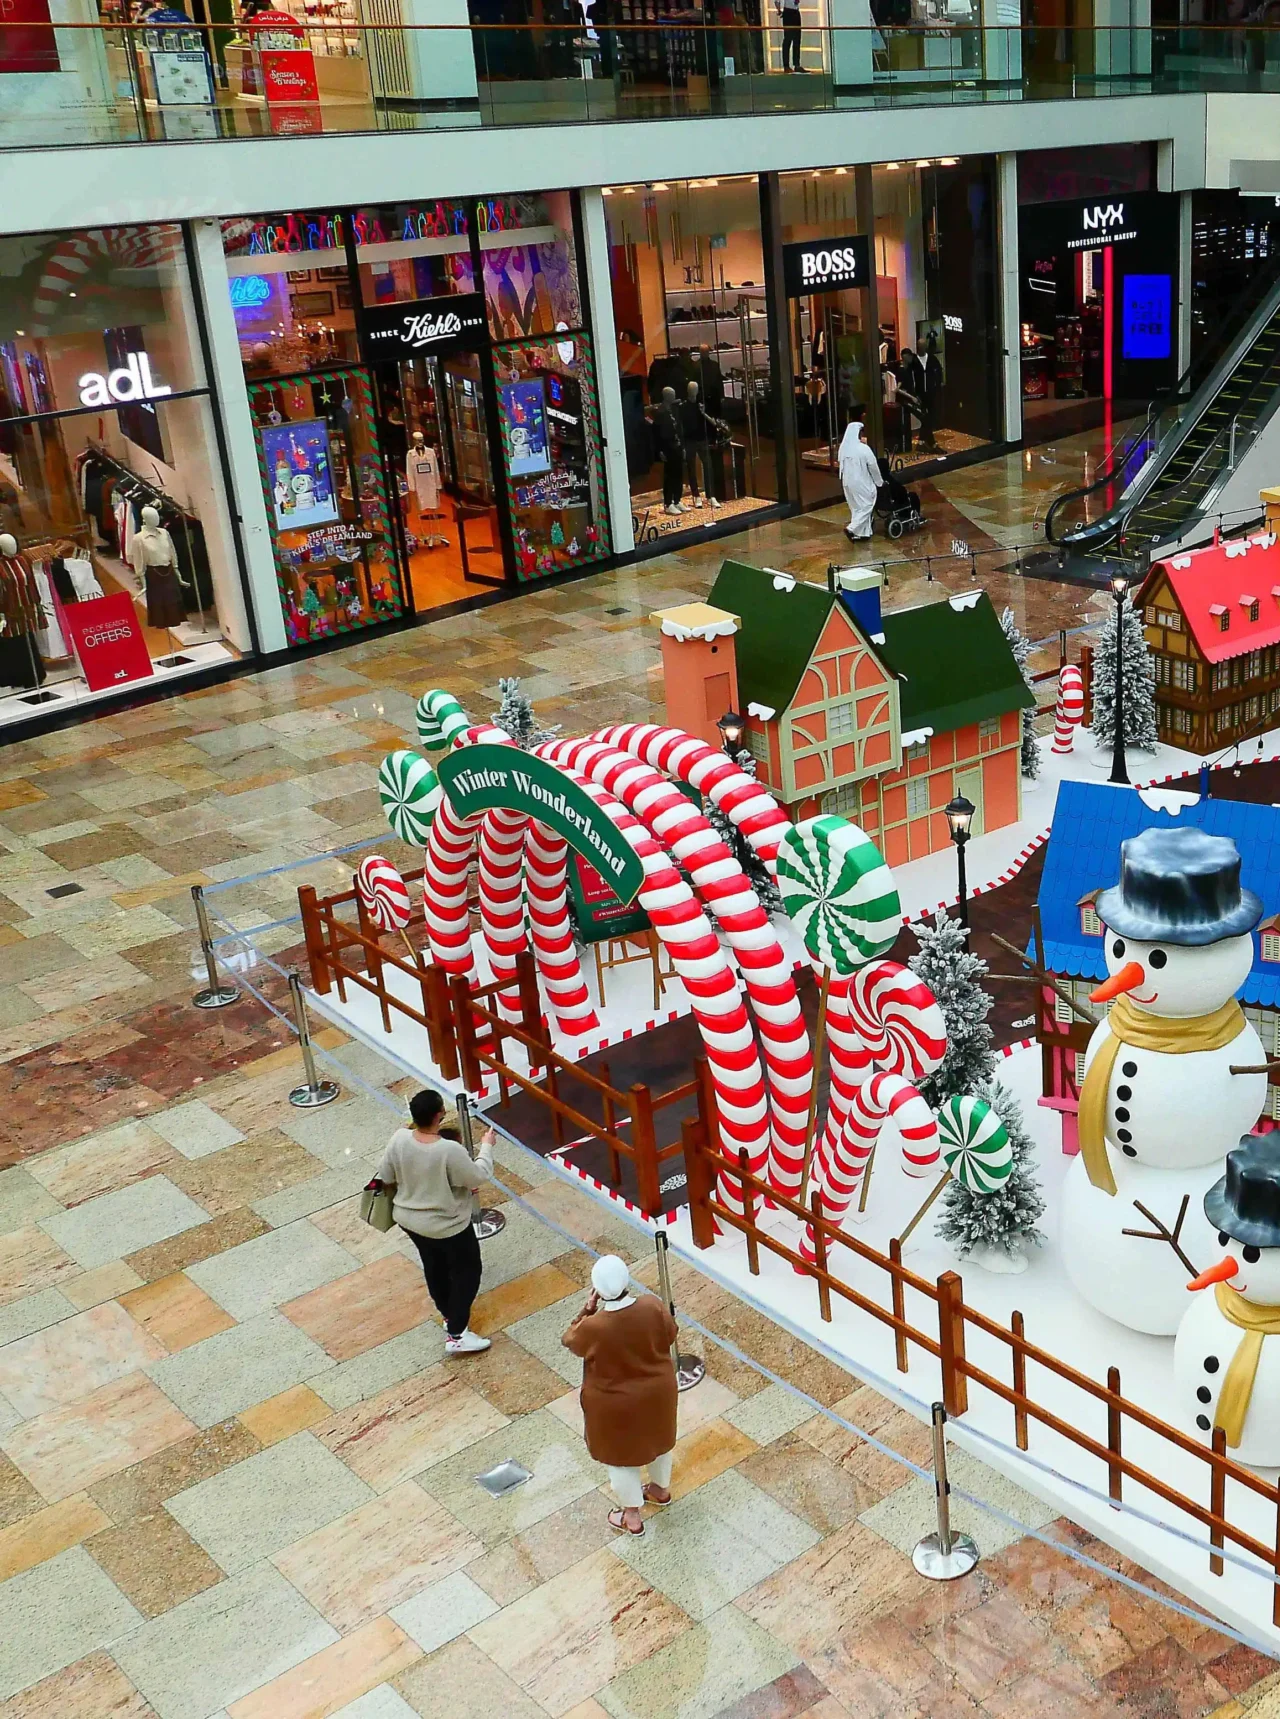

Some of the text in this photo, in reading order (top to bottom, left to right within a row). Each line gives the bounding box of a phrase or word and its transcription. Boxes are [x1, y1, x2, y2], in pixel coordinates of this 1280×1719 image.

[1083, 203, 1124, 230] NYX
[1067, 231, 1138, 249] PROFESSIONAL MAKEUP
[801, 247, 856, 278] BOSS
[803, 271, 856, 286] HUGO BOSS
[370, 312, 483, 344] SINCE Kiehl's 1851
[292, 532, 373, 556] KIEHL'S DREAMLAND
[306, 529, 325, 541] STEP
[327, 525, 346, 535] INTO
[82, 618, 129, 635] END OF SEASON
[84, 626, 132, 648] OFFERS
[452, 768, 626, 877] Winter Wonderland
